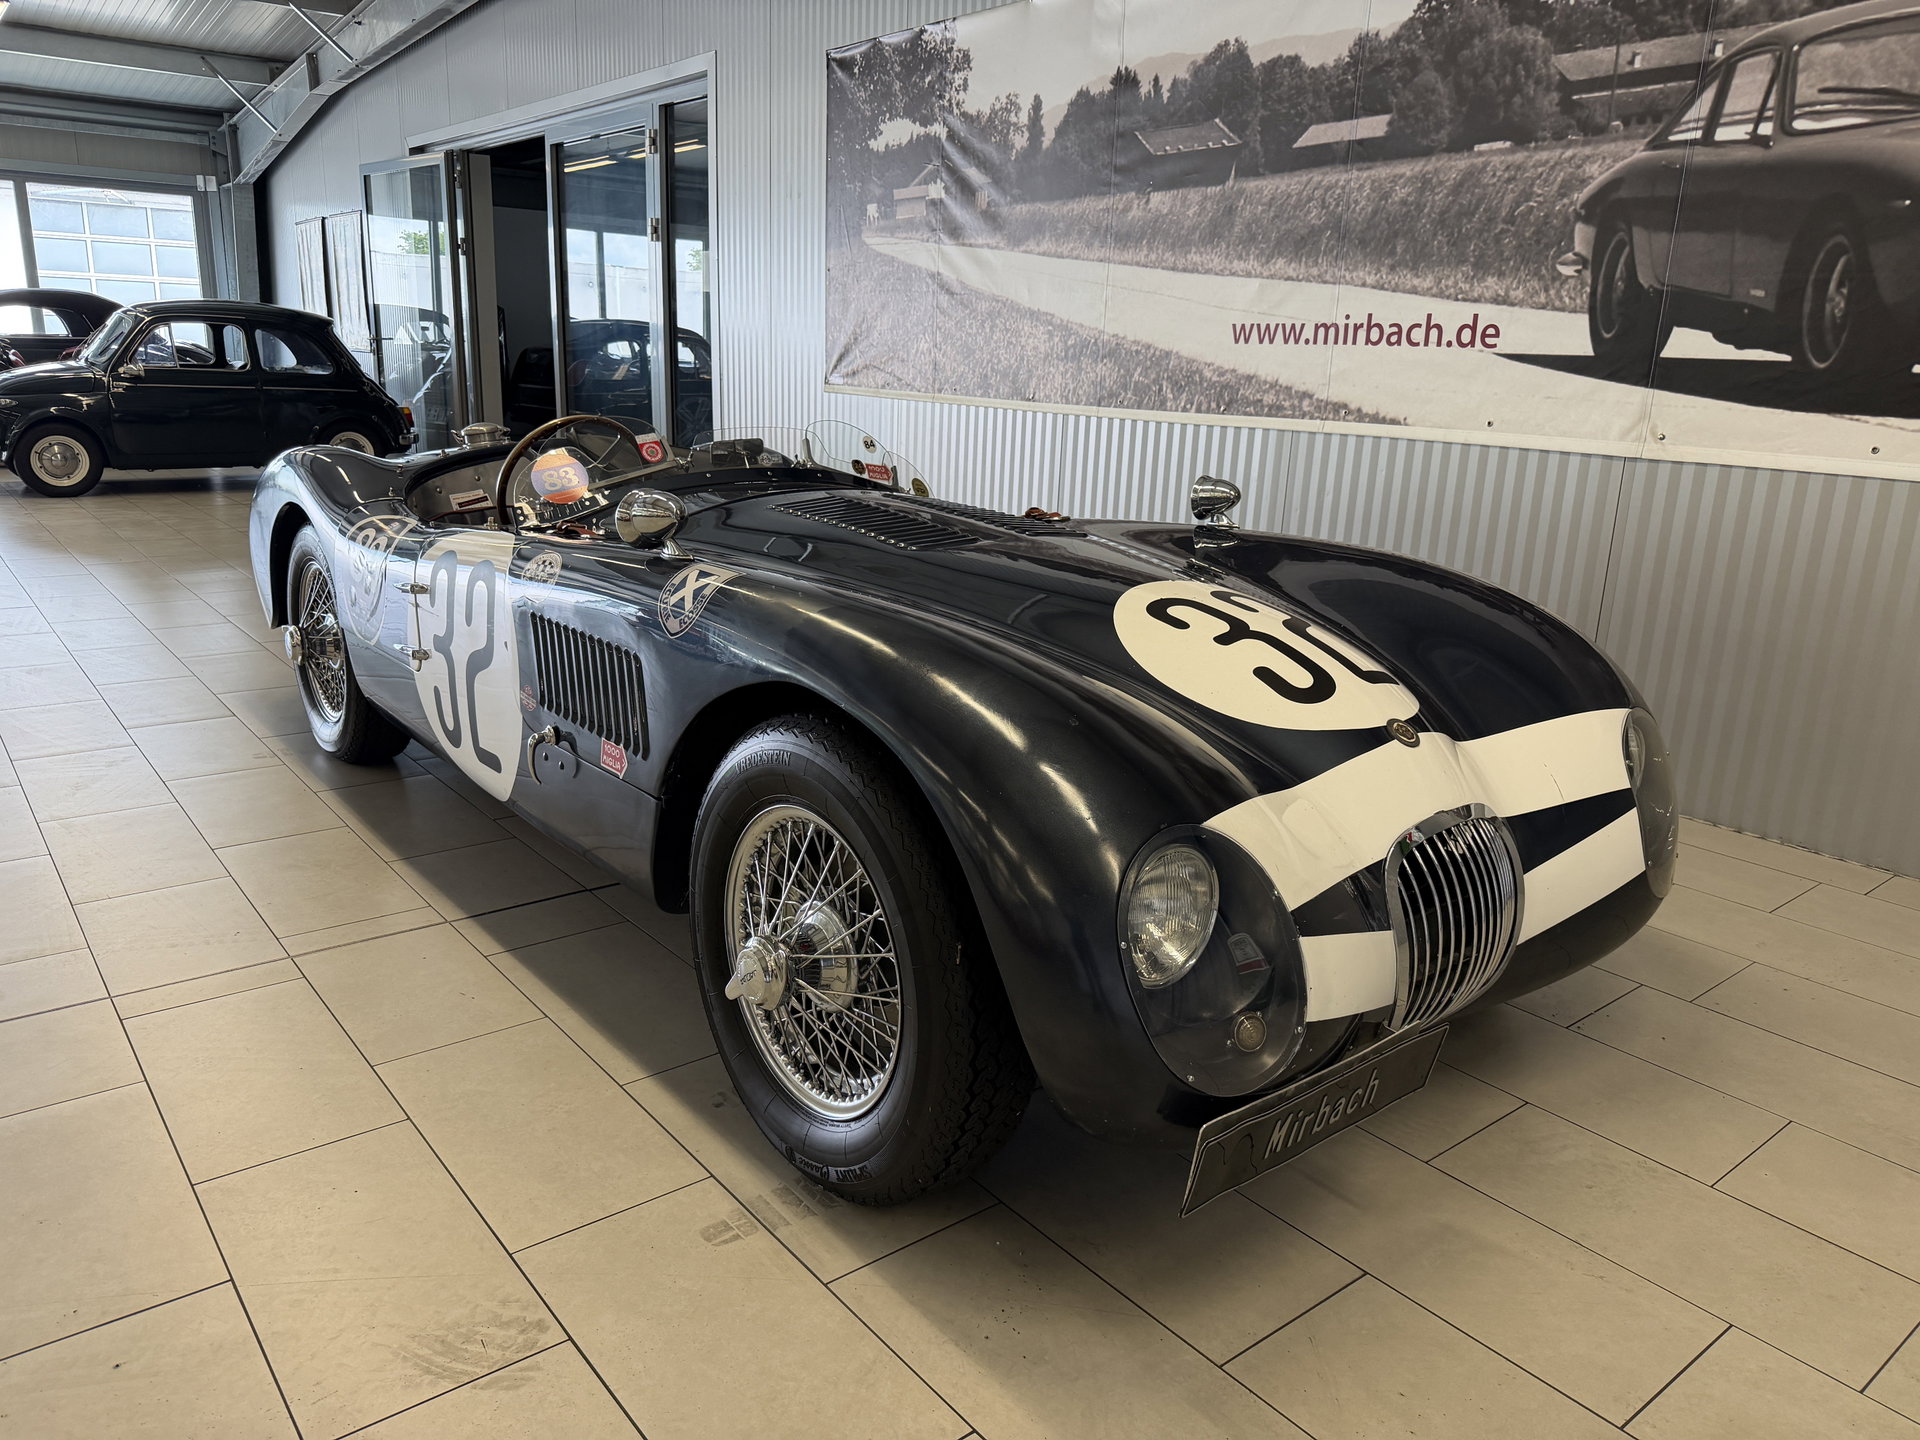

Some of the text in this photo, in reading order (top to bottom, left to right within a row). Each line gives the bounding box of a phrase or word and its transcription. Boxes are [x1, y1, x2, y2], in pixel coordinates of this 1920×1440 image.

[1232, 313, 1500, 348] www.mirbach.de
[864, 439, 876, 450] 84
[541, 466, 579, 491] 83
[661, 582, 677, 624] ECURIE
[679, 593, 708, 629] ECOSSE
[430, 549, 503, 774] 32
[602, 755, 621, 771] MIGLIA
[604, 743, 621, 758] 1000
[735, 750, 792, 774] VREDESTEIN
[1264, 1067, 1379, 1160] Mirbach
